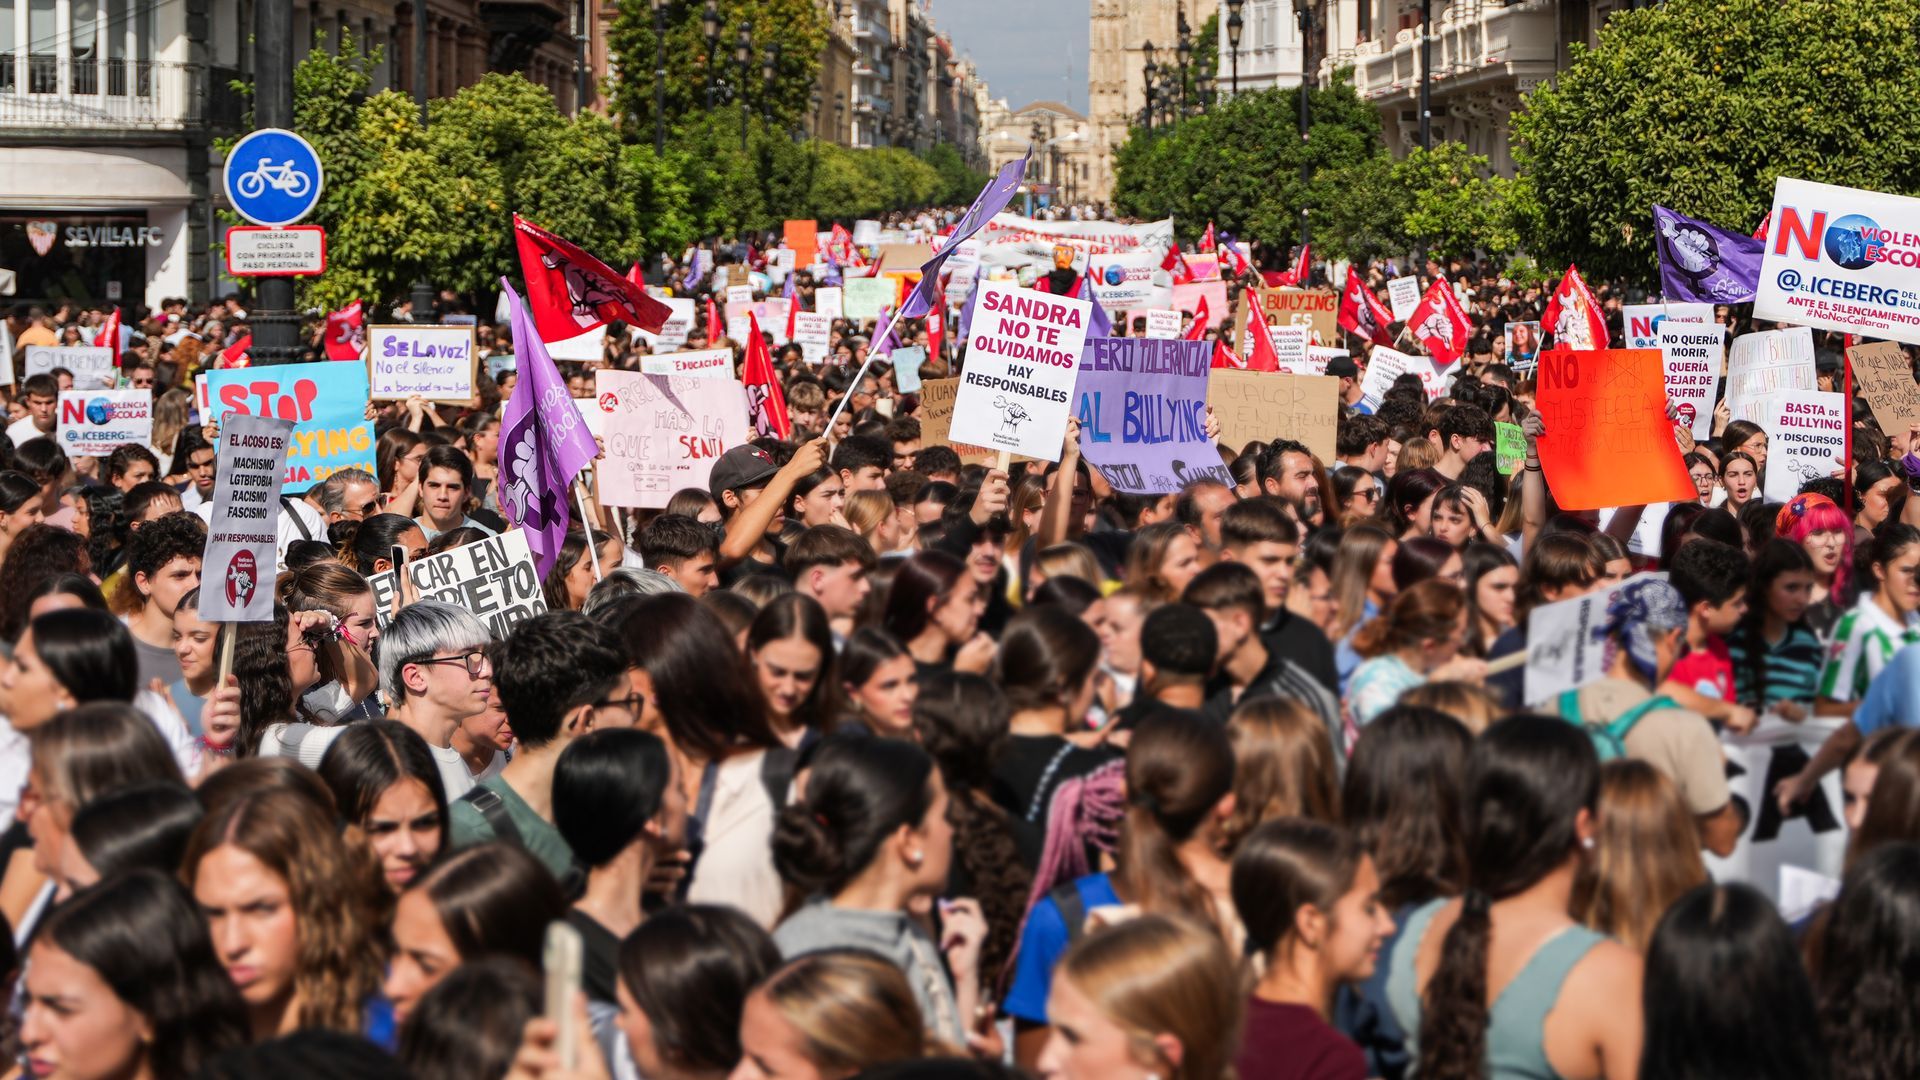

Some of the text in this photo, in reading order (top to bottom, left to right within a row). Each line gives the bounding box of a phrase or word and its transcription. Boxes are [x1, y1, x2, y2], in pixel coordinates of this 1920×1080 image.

[64, 226, 163, 247] SEVILLA FC
[251, 232, 299, 240] ITINERARIO
[236, 252, 256, 260] CON
[258, 251, 302, 259] PRIORIDAD
[242, 261, 309, 269] PASO PEATONAL
[983, 291, 1081, 328] SANDRA
[1787, 296, 1815, 309] ANTE
[1818, 301, 1829, 311] EL
[1806, 308, 1890, 330] #NoNosCallaran
[998, 318, 1060, 346] NO TE
[1662, 334, 1678, 344] NO
[1681, 333, 1719, 346] QUERÍA
[975, 335, 1074, 369] OLVIDAMOS
[1139, 338, 1208, 377] TOLERANCIA
[1671, 347, 1709, 359] MORIR,
[1007, 364, 1034, 380] HAY
[1544, 354, 1580, 390] NO
[1669, 360, 1708, 373] QUERÍA
[1664, 375, 1712, 385] DEJAR DE
[966, 372, 1067, 403] RESPONSABLES
[1667, 388, 1705, 398] SUFRIR
[106, 410, 147, 419] ESCOLAR
[1786, 402, 1840, 417] BASTA DE
[1079, 390, 1208, 445] AL BULLYING
[1780, 415, 1843, 430] BULLYING
[229, 434, 284, 450] EL ACOSO ES:
[610, 432, 651, 460] QUE
[1784, 433, 1843, 446] DISCURSOS
[1786, 446, 1832, 458] DE ODIO
[233, 457, 275, 471] MACHISMO
[230, 474, 273, 487] LGTBIFOBIA
[232, 490, 267, 503] RACISMO
[227, 506, 267, 520] FASCISMO
[212, 533, 276, 544] ¡HAY RESPONSABLES!
[468, 535, 511, 577] EN
